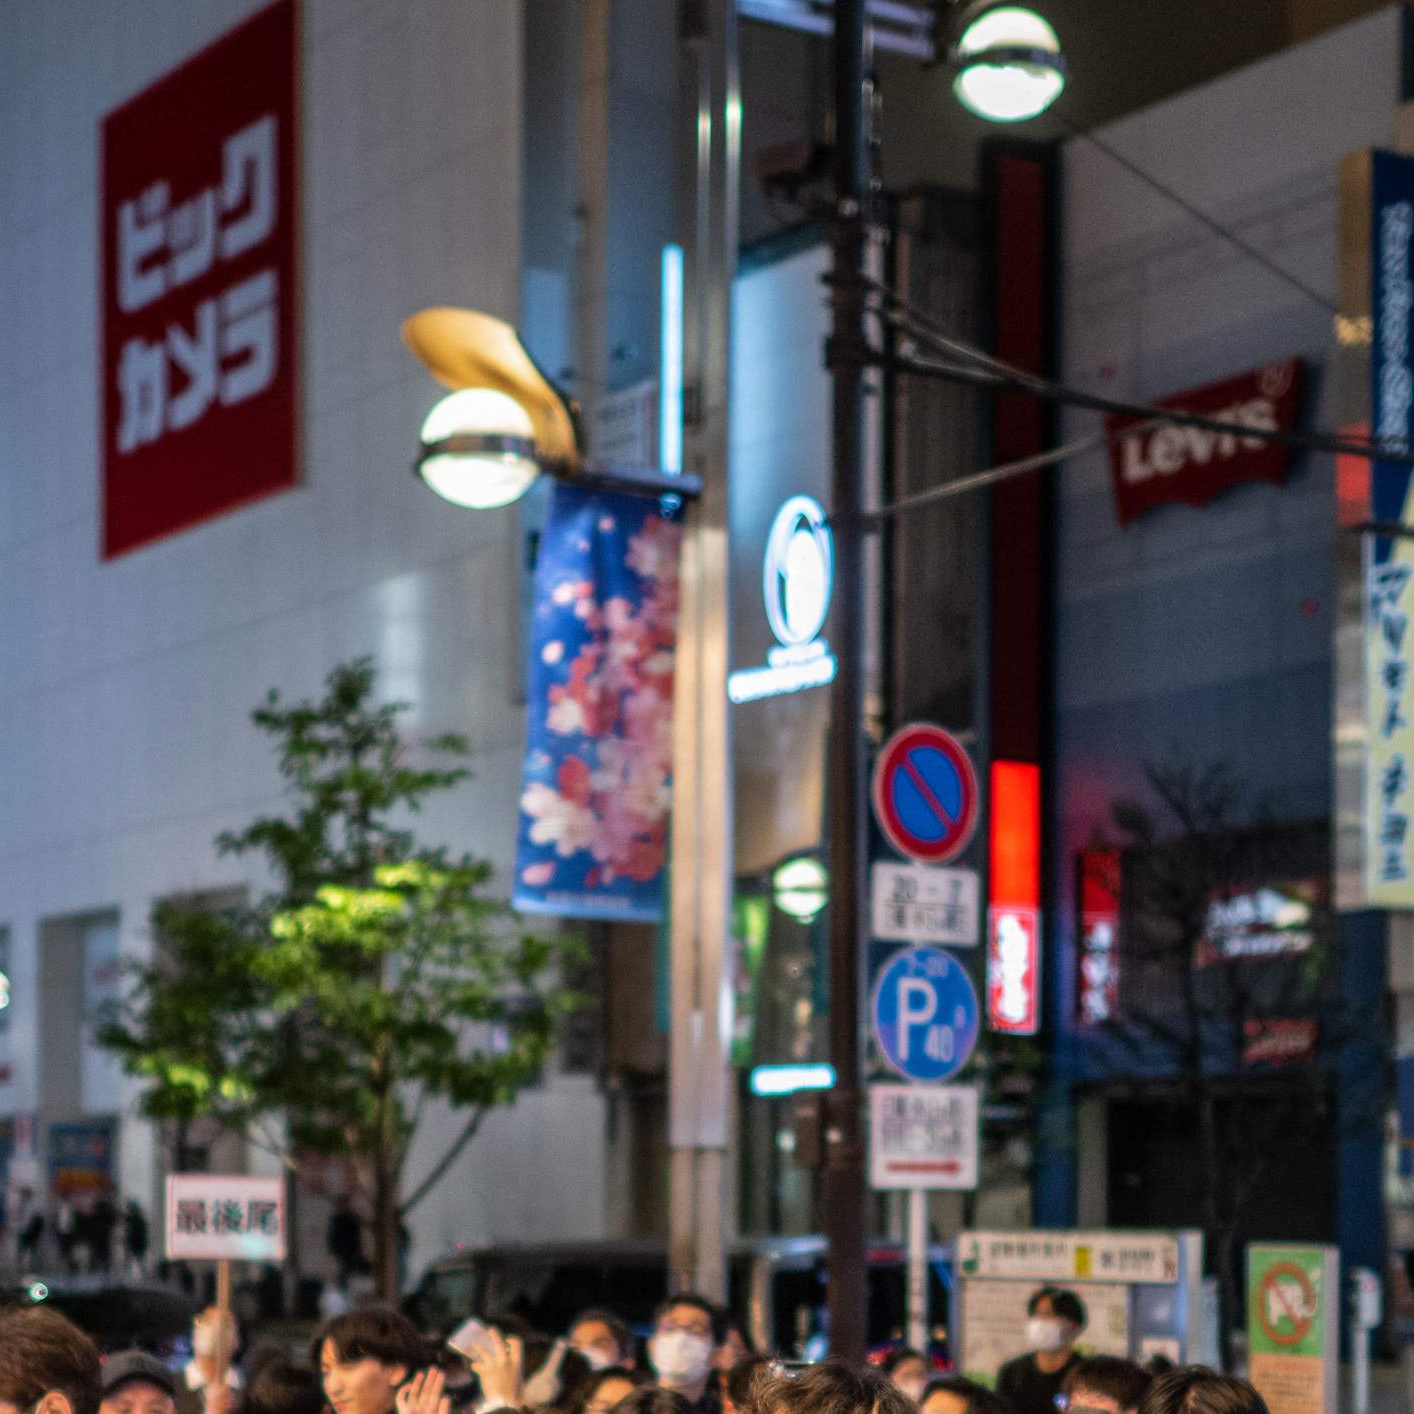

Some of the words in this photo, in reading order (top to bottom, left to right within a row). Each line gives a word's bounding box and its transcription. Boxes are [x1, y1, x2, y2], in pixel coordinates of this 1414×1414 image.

[116, 268, 278, 455] カメラ
[897, 976, 937, 1062] P
[176, 1198, 278, 1236] 最後尾
